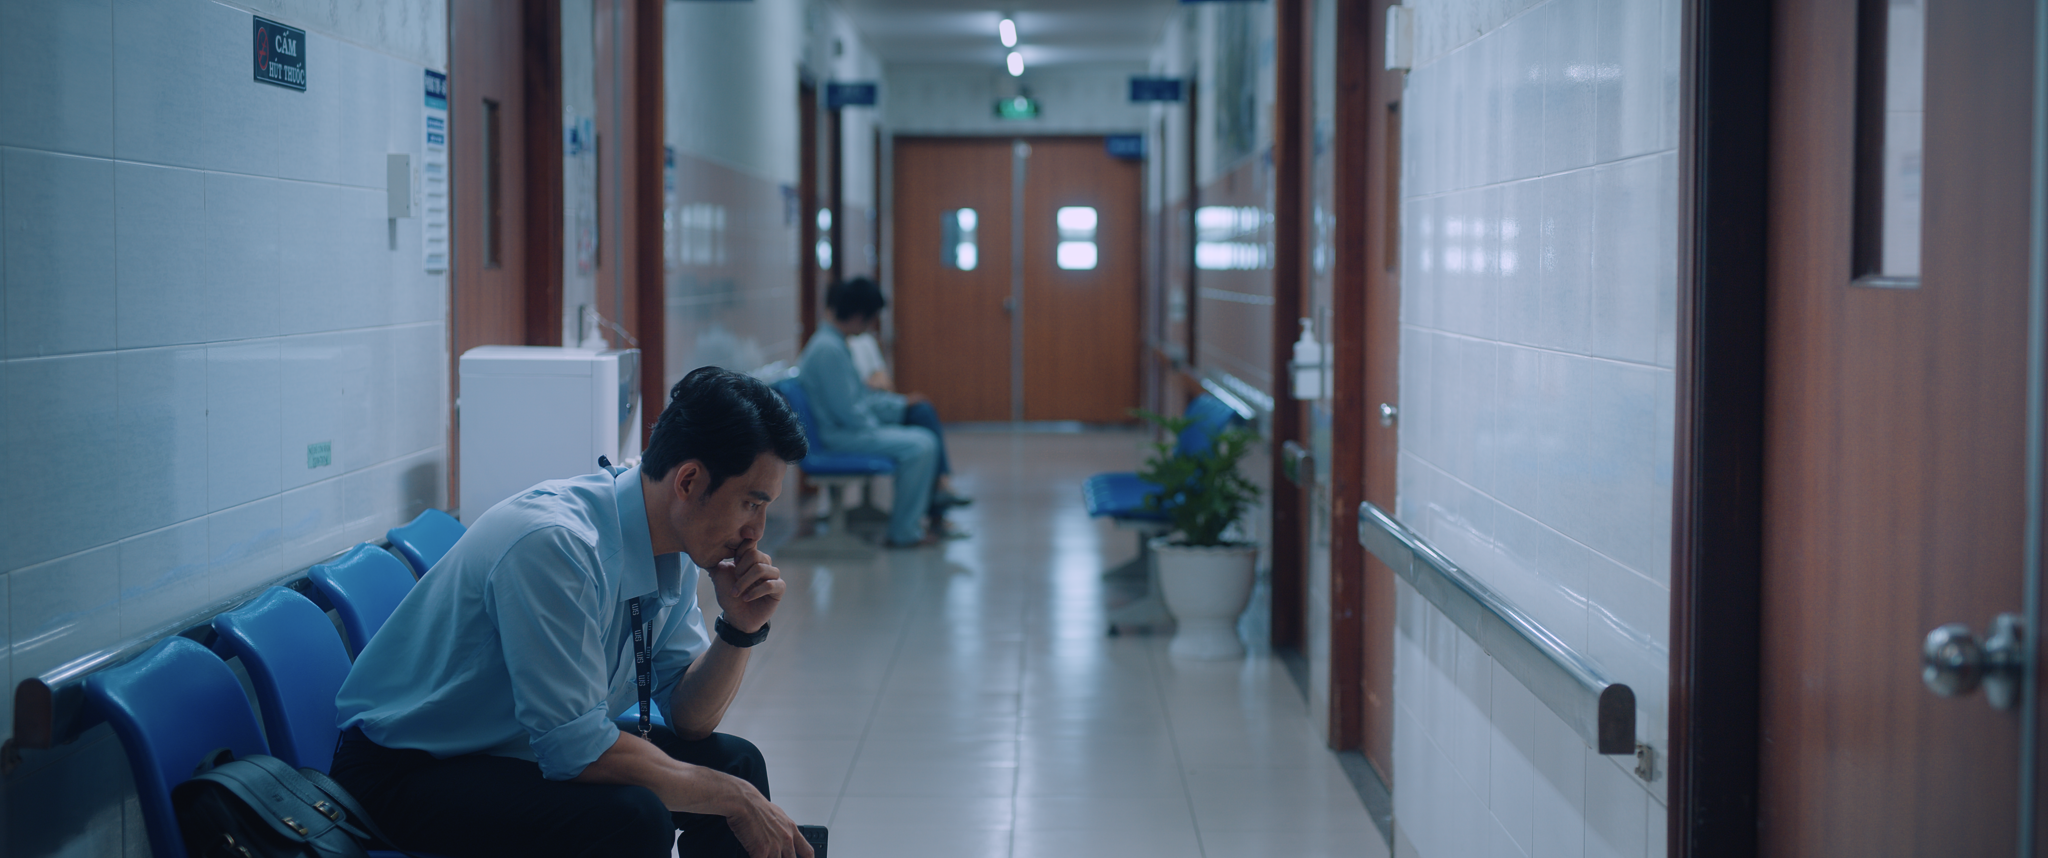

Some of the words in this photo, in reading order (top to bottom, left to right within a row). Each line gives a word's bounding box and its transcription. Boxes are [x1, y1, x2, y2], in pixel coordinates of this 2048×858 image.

[275, 30, 297, 57] CẤM
[269, 57, 282, 79] HÚT
[284, 62, 305, 85] THUỐC
